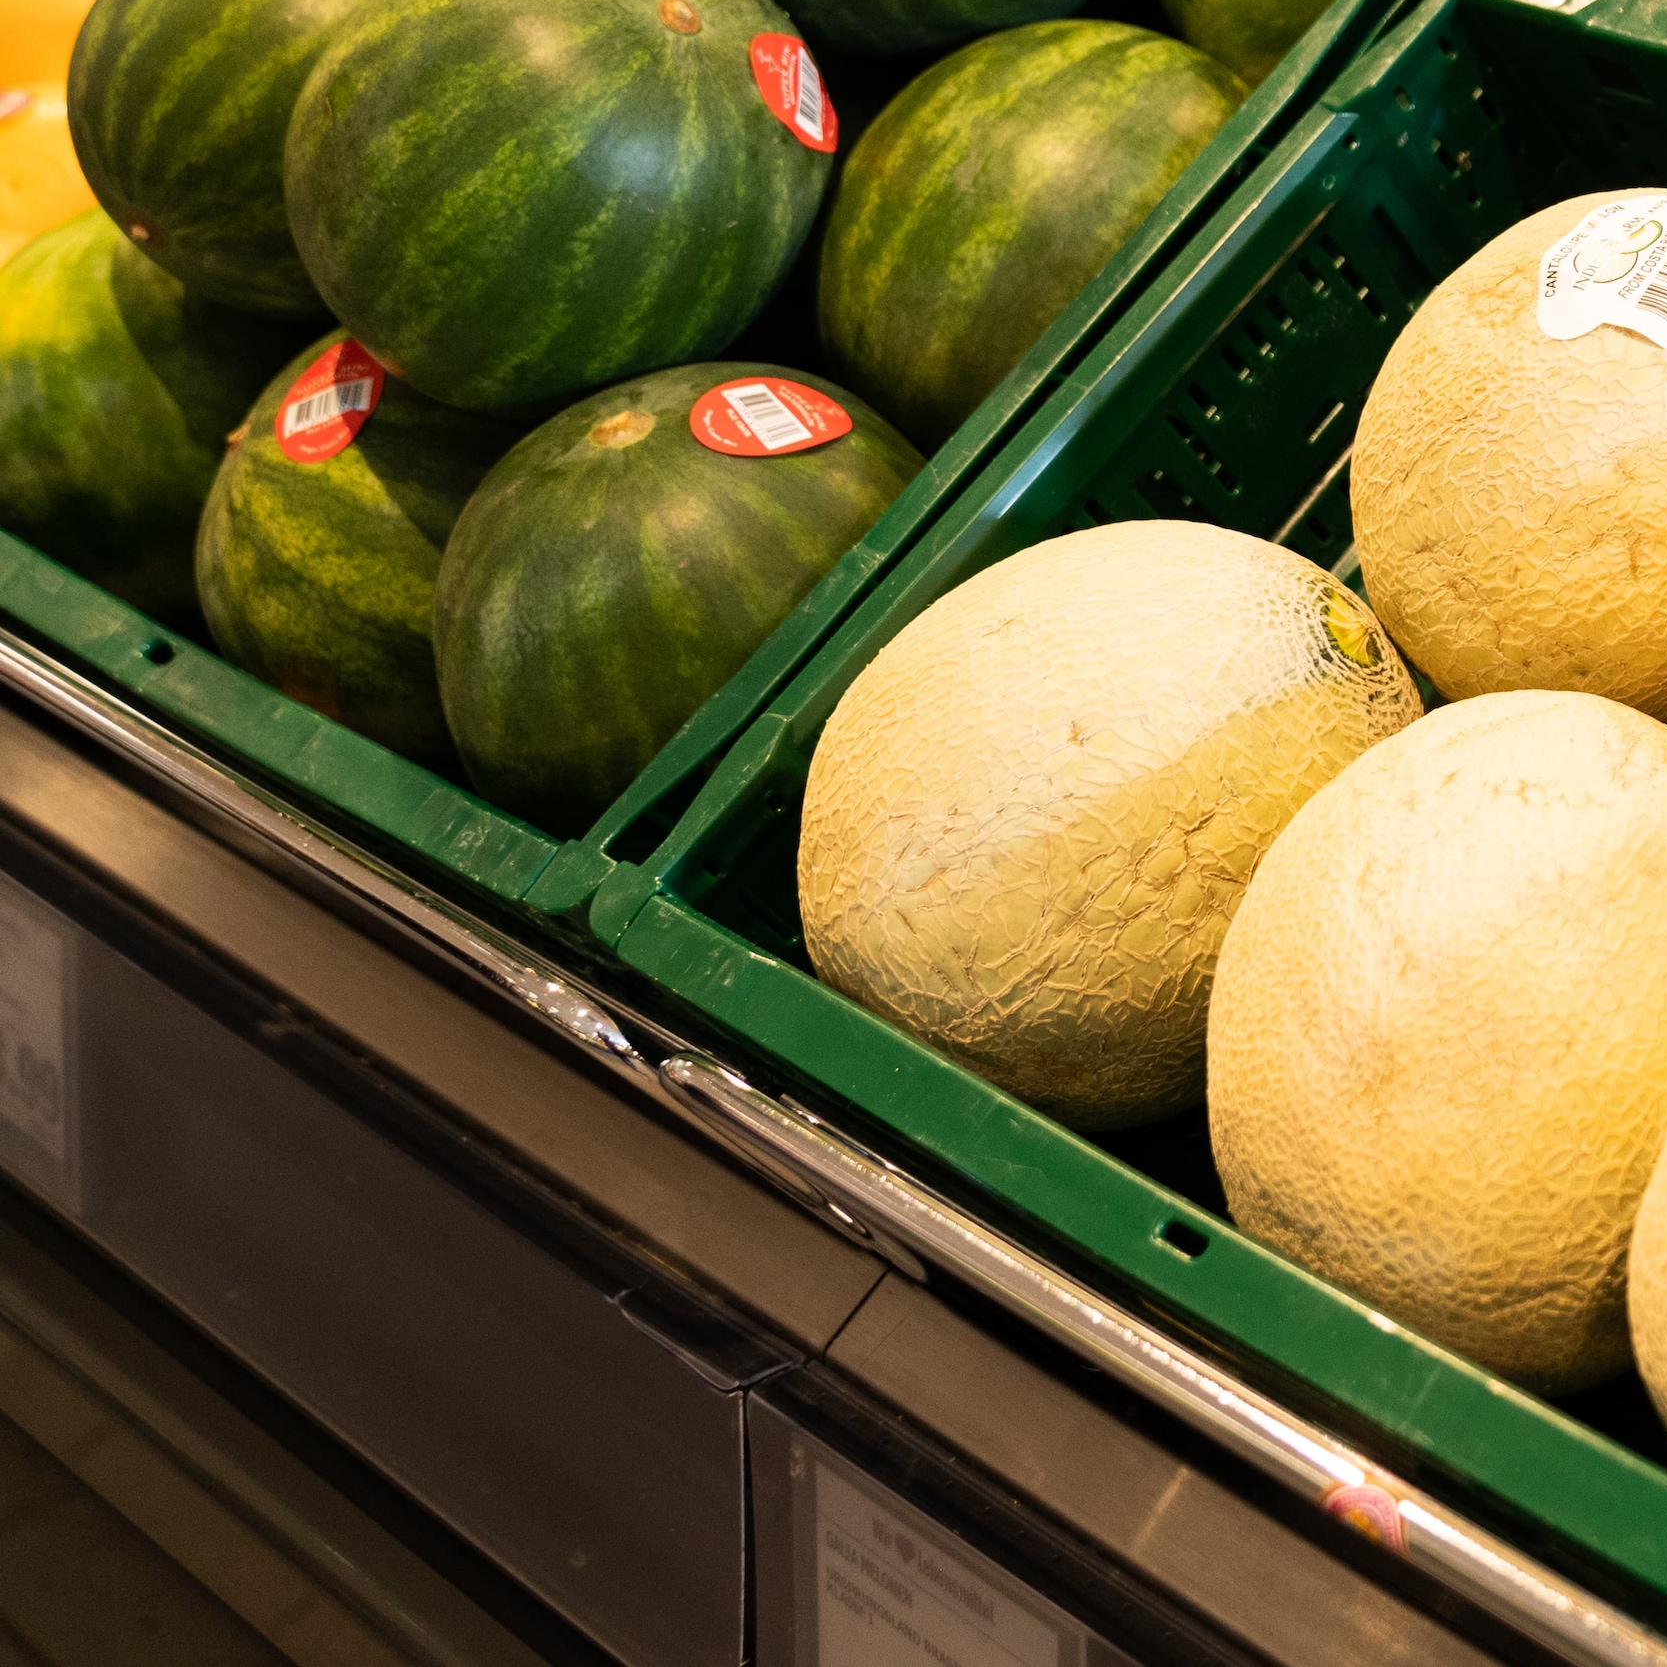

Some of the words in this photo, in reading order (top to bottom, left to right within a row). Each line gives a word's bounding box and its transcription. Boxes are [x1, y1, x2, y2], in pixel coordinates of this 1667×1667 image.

[1544, 232, 1590, 299] CANTALOUPE
[1585, 204, 1626, 231] MLON
[1617, 273, 1647, 300] FROM
